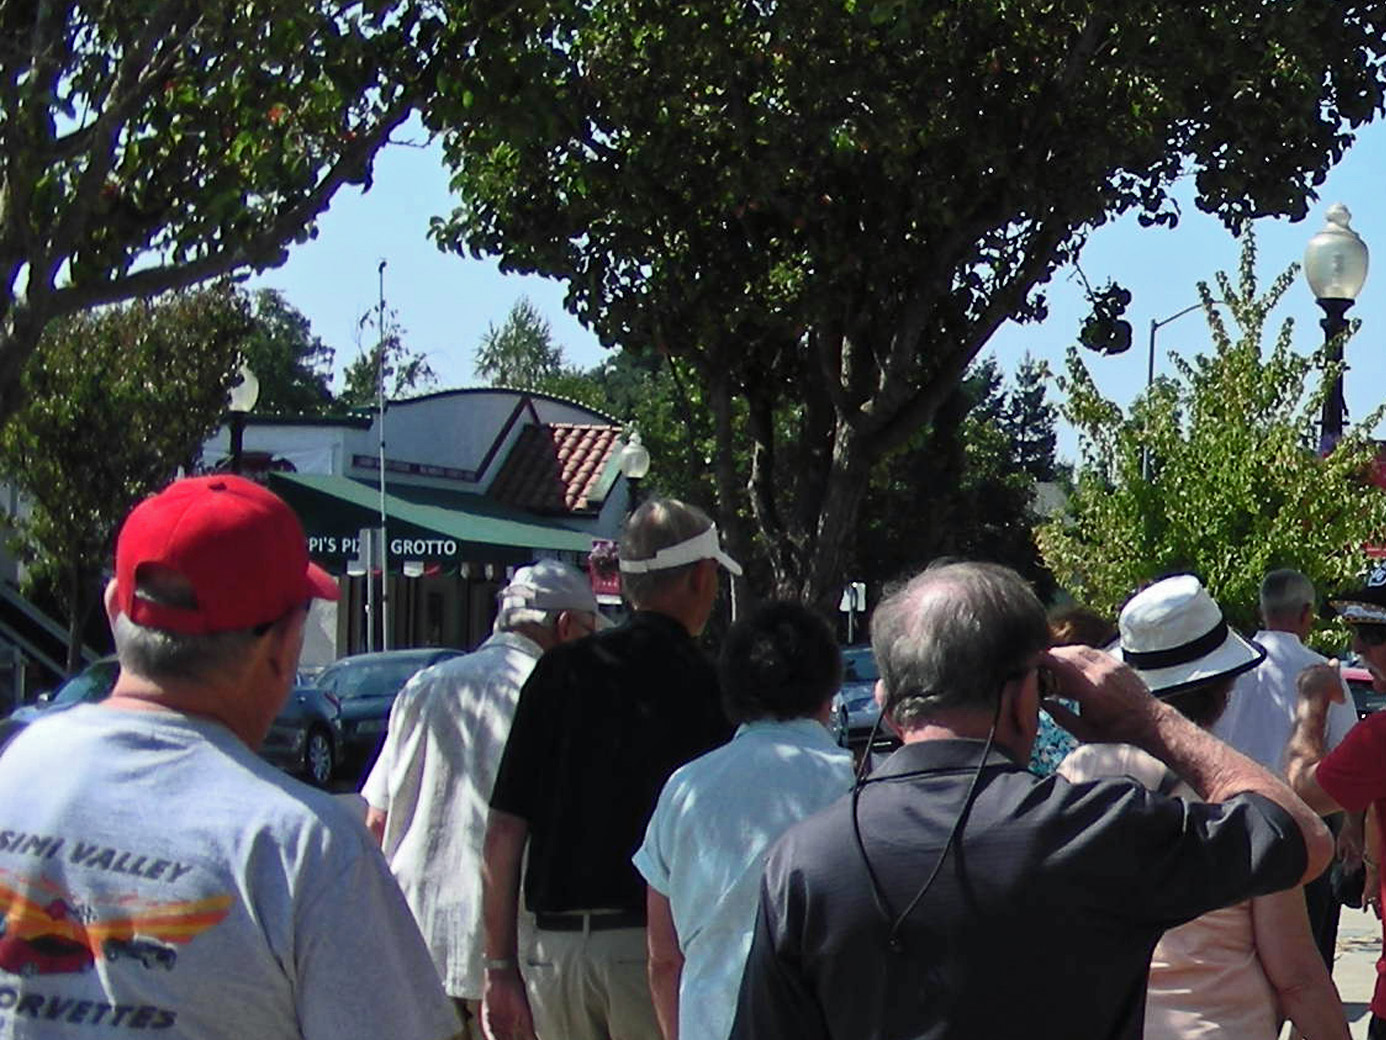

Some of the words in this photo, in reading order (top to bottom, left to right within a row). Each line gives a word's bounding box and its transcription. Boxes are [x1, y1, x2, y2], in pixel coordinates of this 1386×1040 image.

[307, 536, 337, 553] PI'S
[390, 539, 457, 556] GROTTO
[0, 830, 65, 859] SIMI
[69, 841, 193, 883] VALLEY
[0, 987, 178, 1029] ORVETTES
